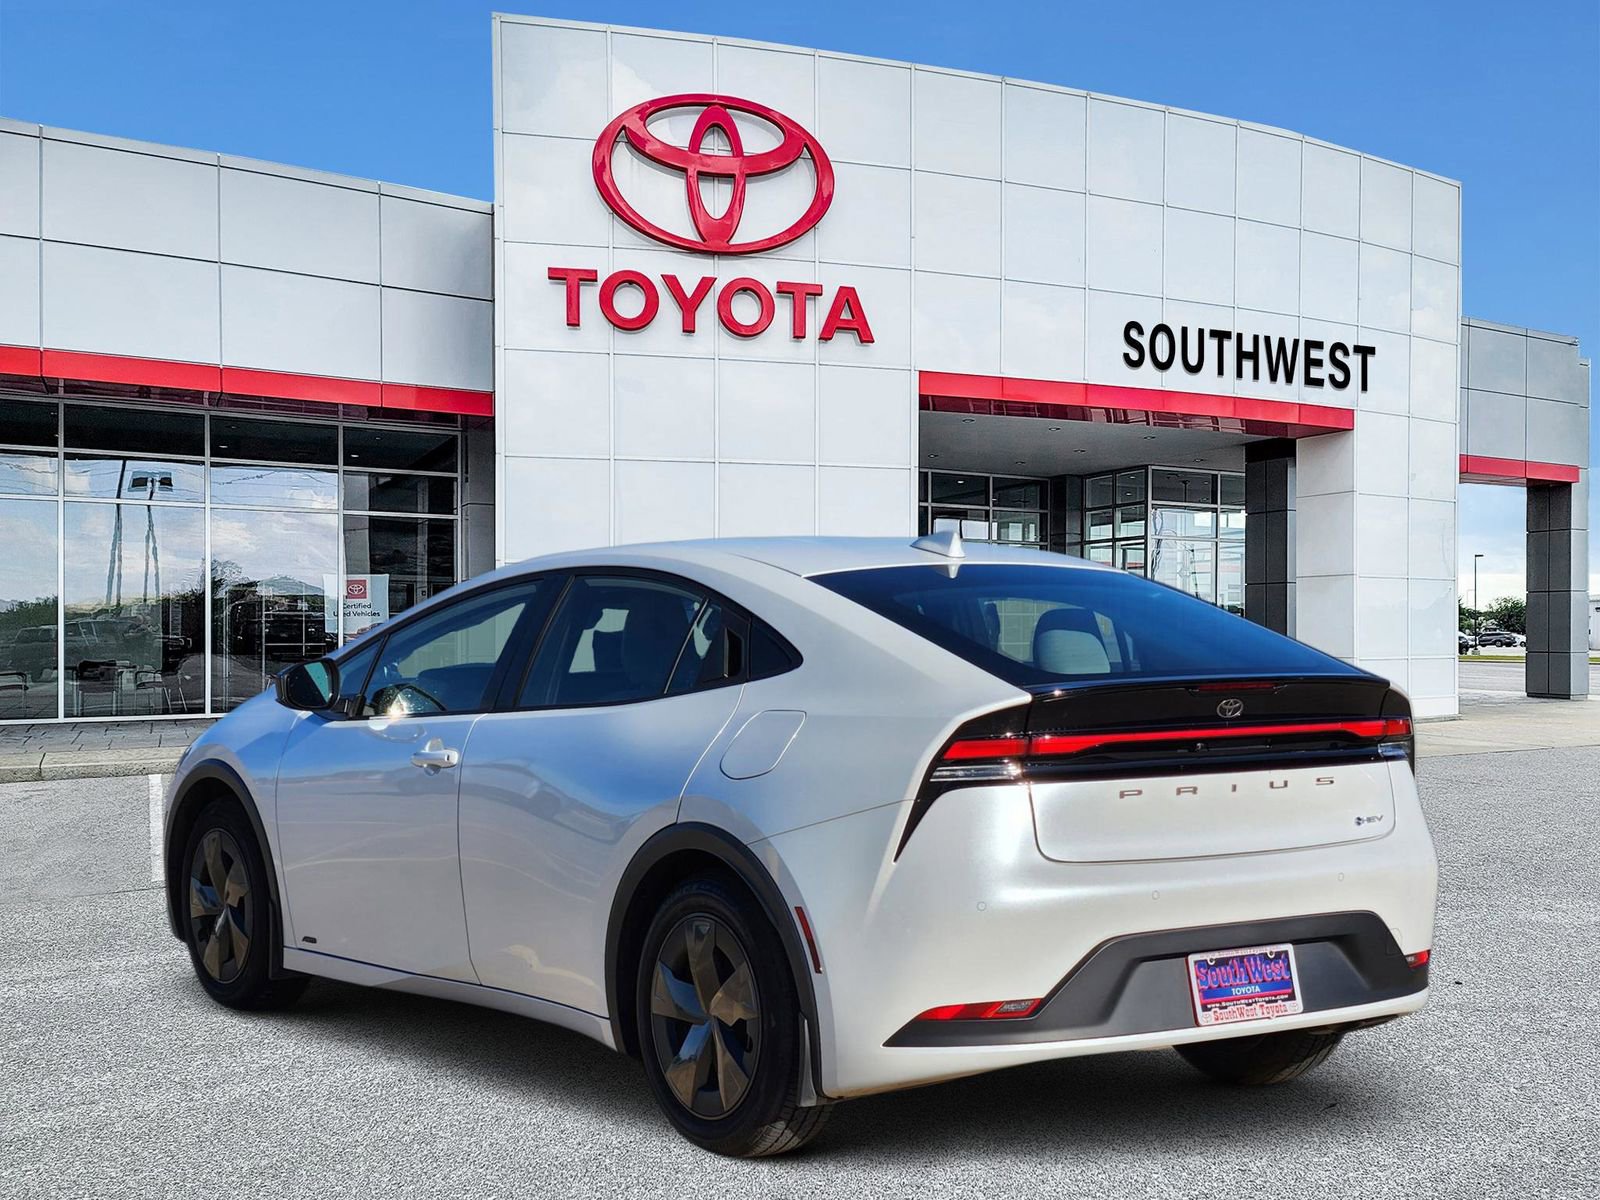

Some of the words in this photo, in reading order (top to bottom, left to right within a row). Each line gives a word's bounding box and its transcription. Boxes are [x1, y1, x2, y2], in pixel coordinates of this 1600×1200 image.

[548, 267, 875, 343] TOYOTA
[1123, 320, 1376, 392] SOUTHWEST
[1119, 776, 1335, 799] PRIUS
[1231, 985, 1261, 996] TOYOTA
[1259, 1003, 1288, 1018] Toyota
